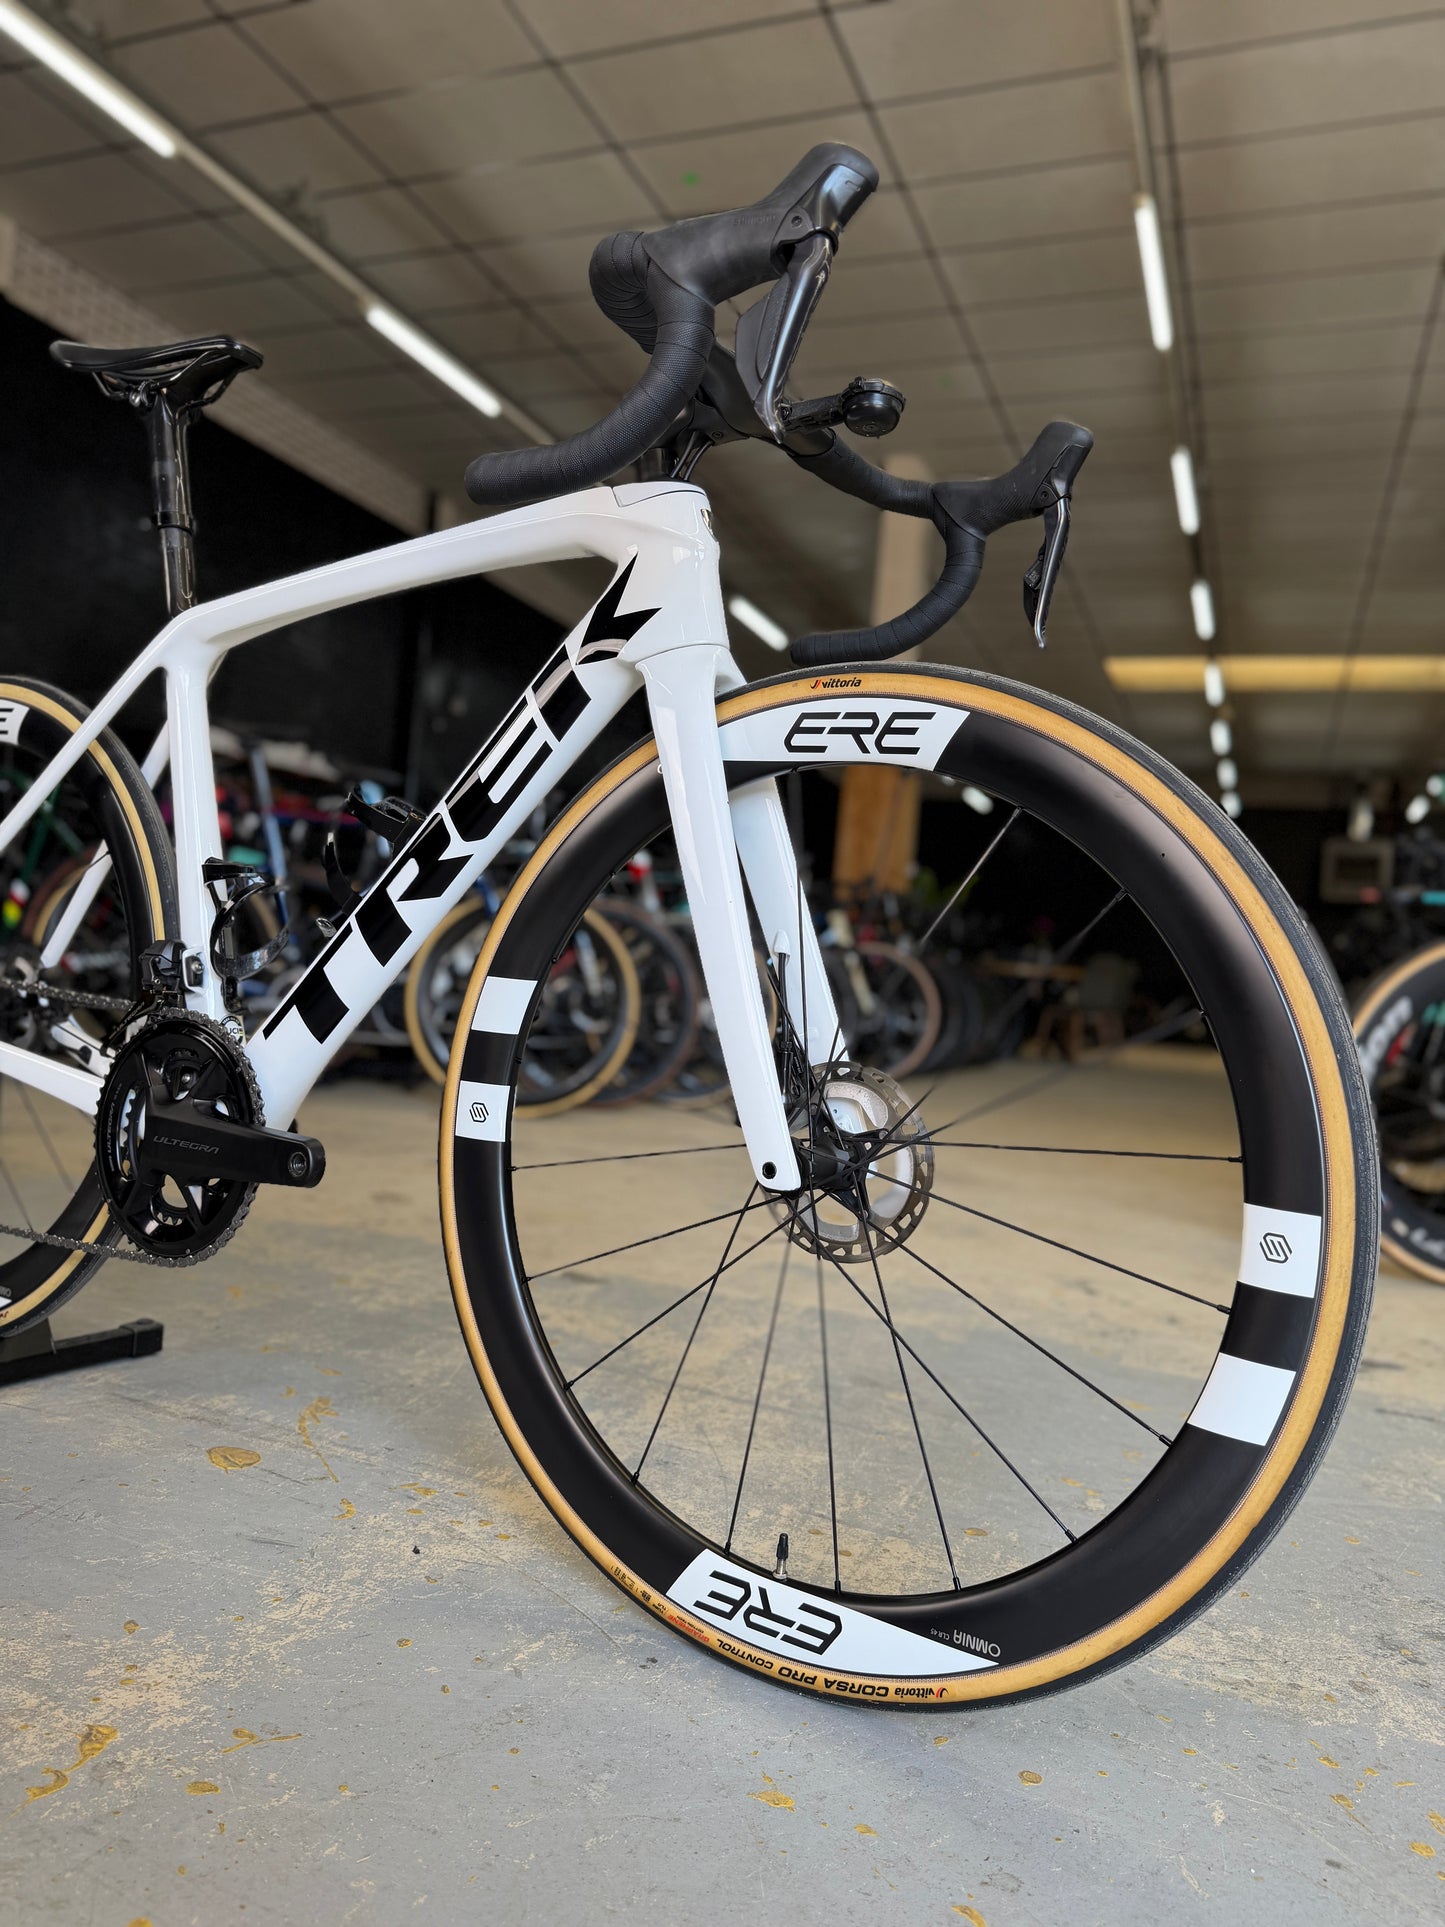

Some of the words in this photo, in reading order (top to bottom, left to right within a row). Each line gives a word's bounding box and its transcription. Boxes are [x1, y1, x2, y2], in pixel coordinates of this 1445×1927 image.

[822, 677, 862, 690] vittoria
[784, 712, 936, 755] ERE
[263, 551, 662, 1044] TREK
[152, 1135, 220, 1155] ULTEGRA
[693, 1570, 842, 1655] ERE
[717, 1638, 773, 1670] CONTROL
[953, 1629, 1001, 1657] OMNIA
[778, 1666, 817, 1685] PRO
[823, 1677, 889, 1697] CORSA
[894, 1687, 936, 1698] vittoria
